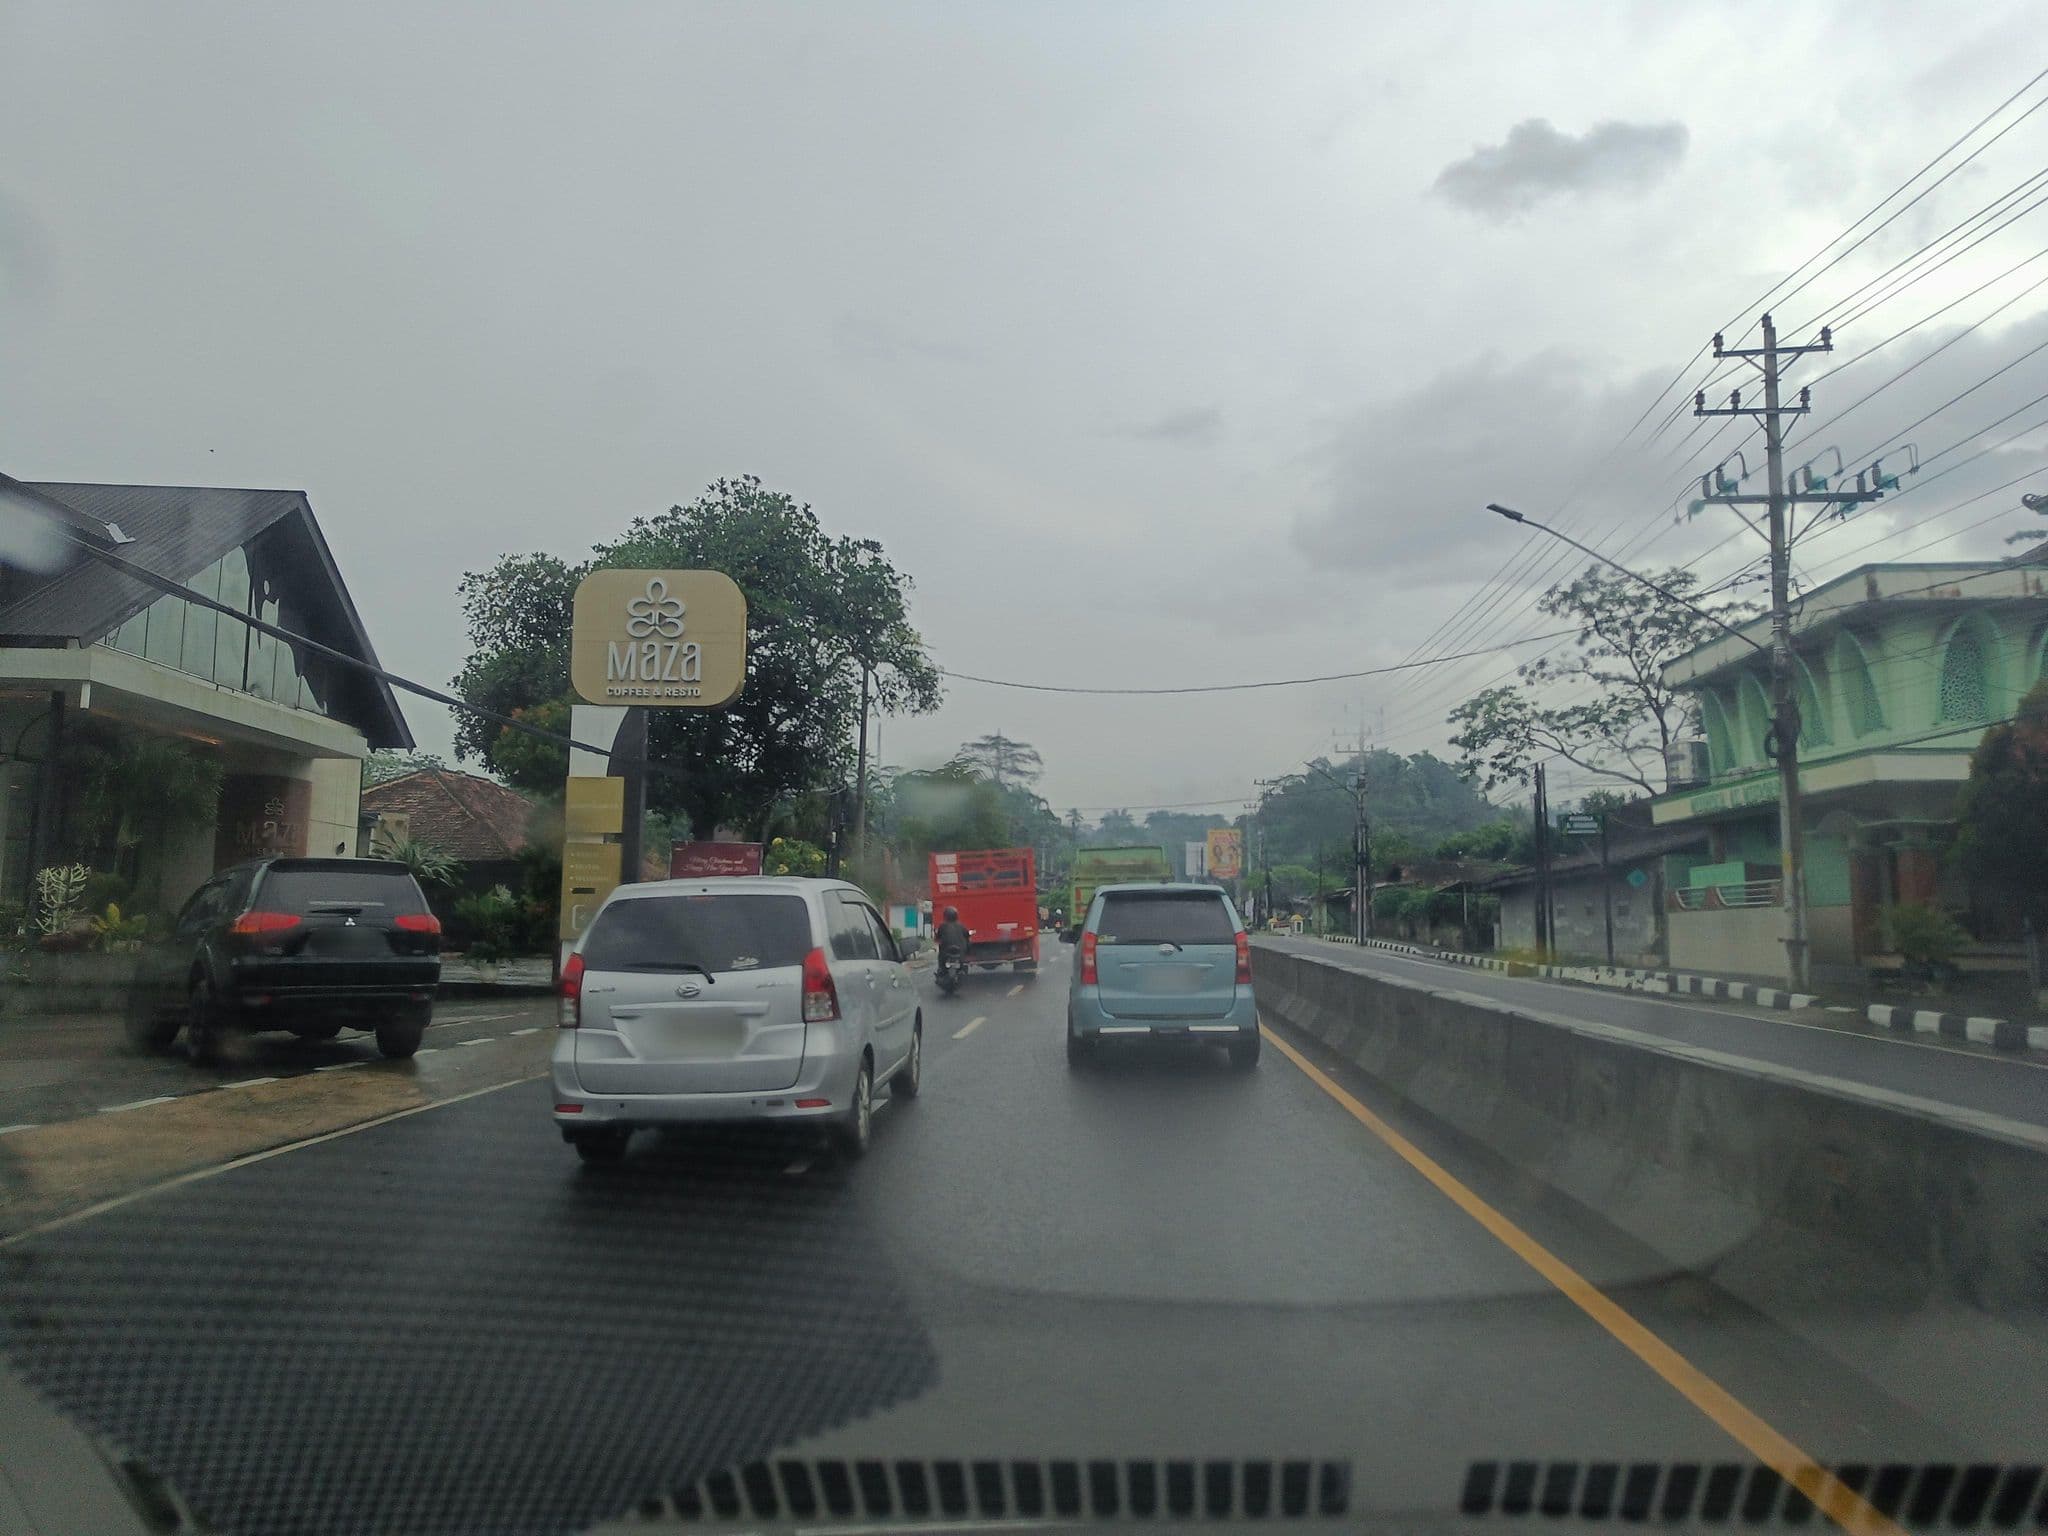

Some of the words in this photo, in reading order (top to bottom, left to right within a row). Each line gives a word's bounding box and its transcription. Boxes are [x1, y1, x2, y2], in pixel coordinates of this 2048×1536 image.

[607, 641, 701, 681] Maza
[607, 687, 650, 697] COFFEE
[652, 687, 661, 697] &
[664, 687, 701, 697] RESTO
